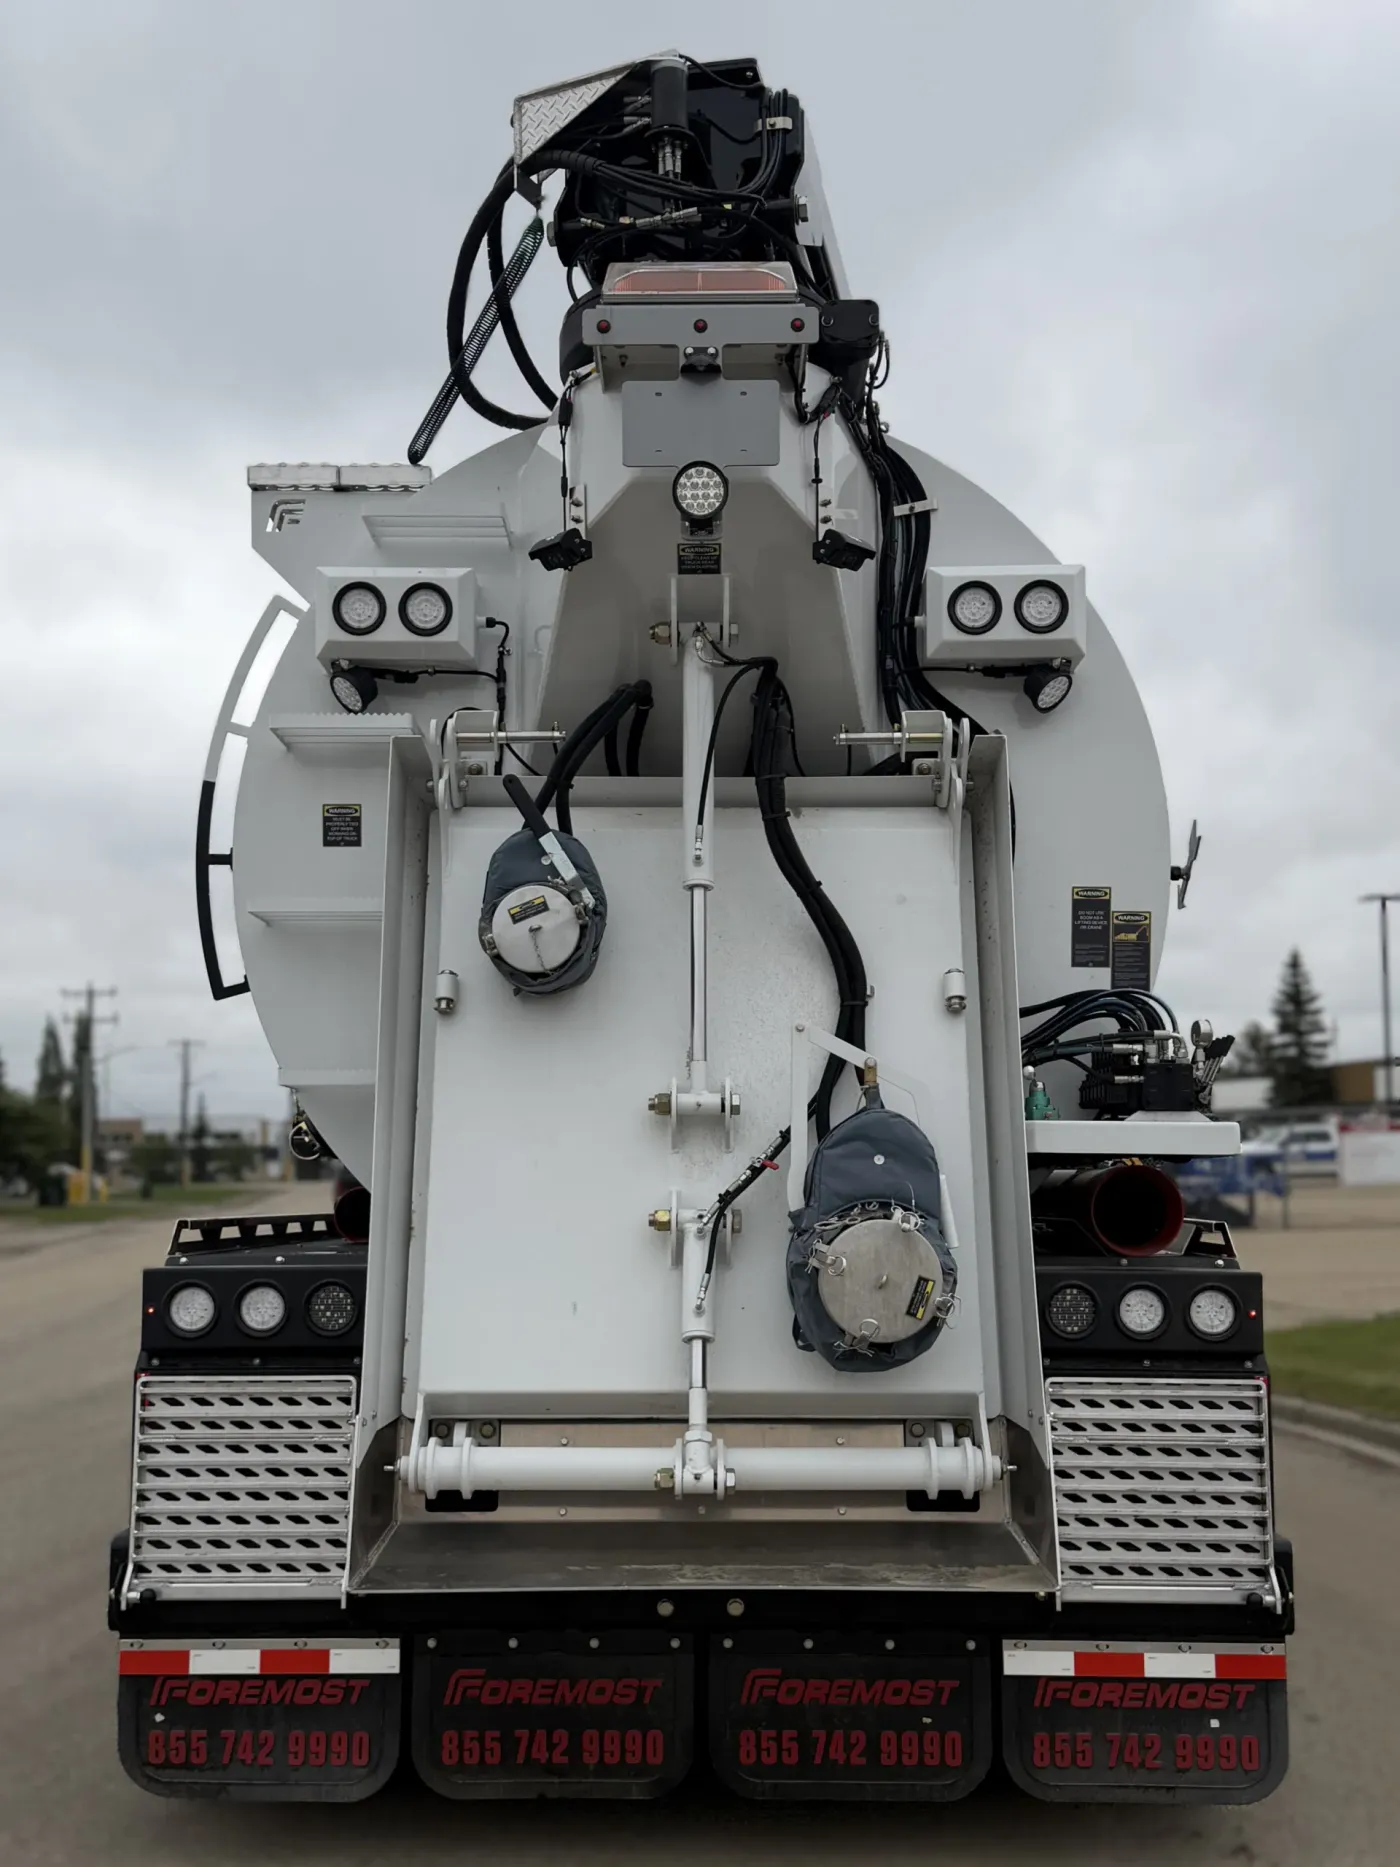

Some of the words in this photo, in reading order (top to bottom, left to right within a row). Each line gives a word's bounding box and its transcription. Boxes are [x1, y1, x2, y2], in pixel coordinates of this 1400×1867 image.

[149, 1676, 370, 1707] FOREMOST
[443, 1669, 662, 1706] FOREMOST
[741, 1668, 960, 1706] FOREMOST
[1033, 1678, 1256, 1710] FOREMOST
[148, 1731, 208, 1767] 855
[221, 1730, 275, 1766] 742
[287, 1731, 370, 1767] 9990
[441, 1731, 501, 1766] 855
[515, 1730, 570, 1765] 742
[582, 1731, 665, 1767] 9990
[739, 1731, 800, 1766] 855
[811, 1730, 867, 1766] 742
[880, 1731, 963, 1768] 9990
[1033, 1733, 1094, 1769] 855
[1106, 1733, 1162, 1769] 742
[1175, 1734, 1260, 1772] 9990
